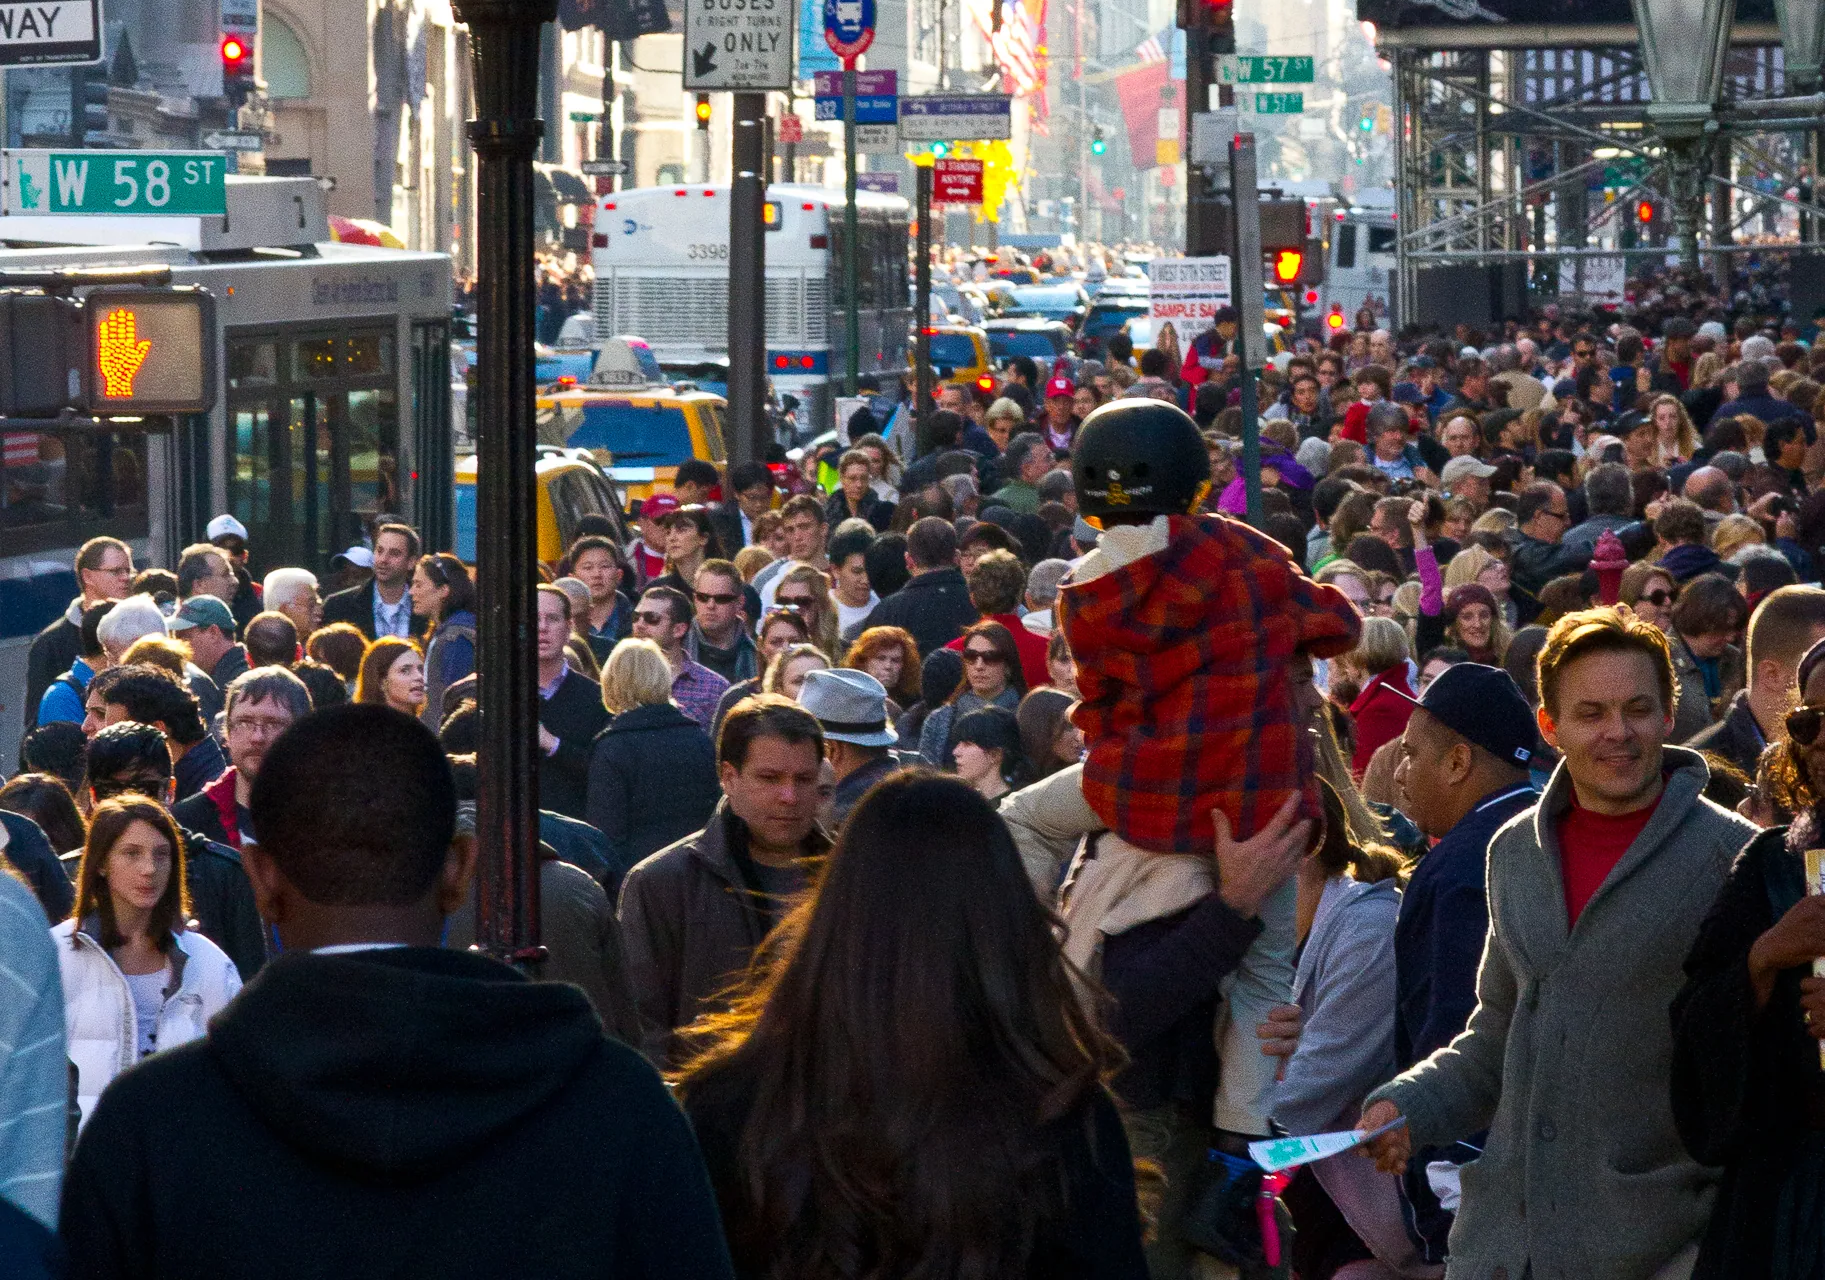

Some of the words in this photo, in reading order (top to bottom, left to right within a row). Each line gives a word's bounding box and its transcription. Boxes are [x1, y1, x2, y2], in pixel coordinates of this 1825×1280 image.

[708, 16, 740, 27] RIGHT
[746, 15, 782, 27] TURNS
[723, 31, 782, 54] ONLY
[1239, 58, 1253, 80] W
[1262, 58, 1289, 80] 57
[1294, 58, 1308, 70] ST
[1258, 94, 1268, 113] W
[935, 160, 947, 171] NO
[54, 159, 89, 207] W
[113, 159, 171, 208] 58
[183, 160, 215, 185] ST
[941, 174, 976, 185] ANYTIME
[688, 243, 729, 259] 3398
[1153, 303, 1196, 318] SAMPLE
[1199, 303, 1226, 318] SAL
